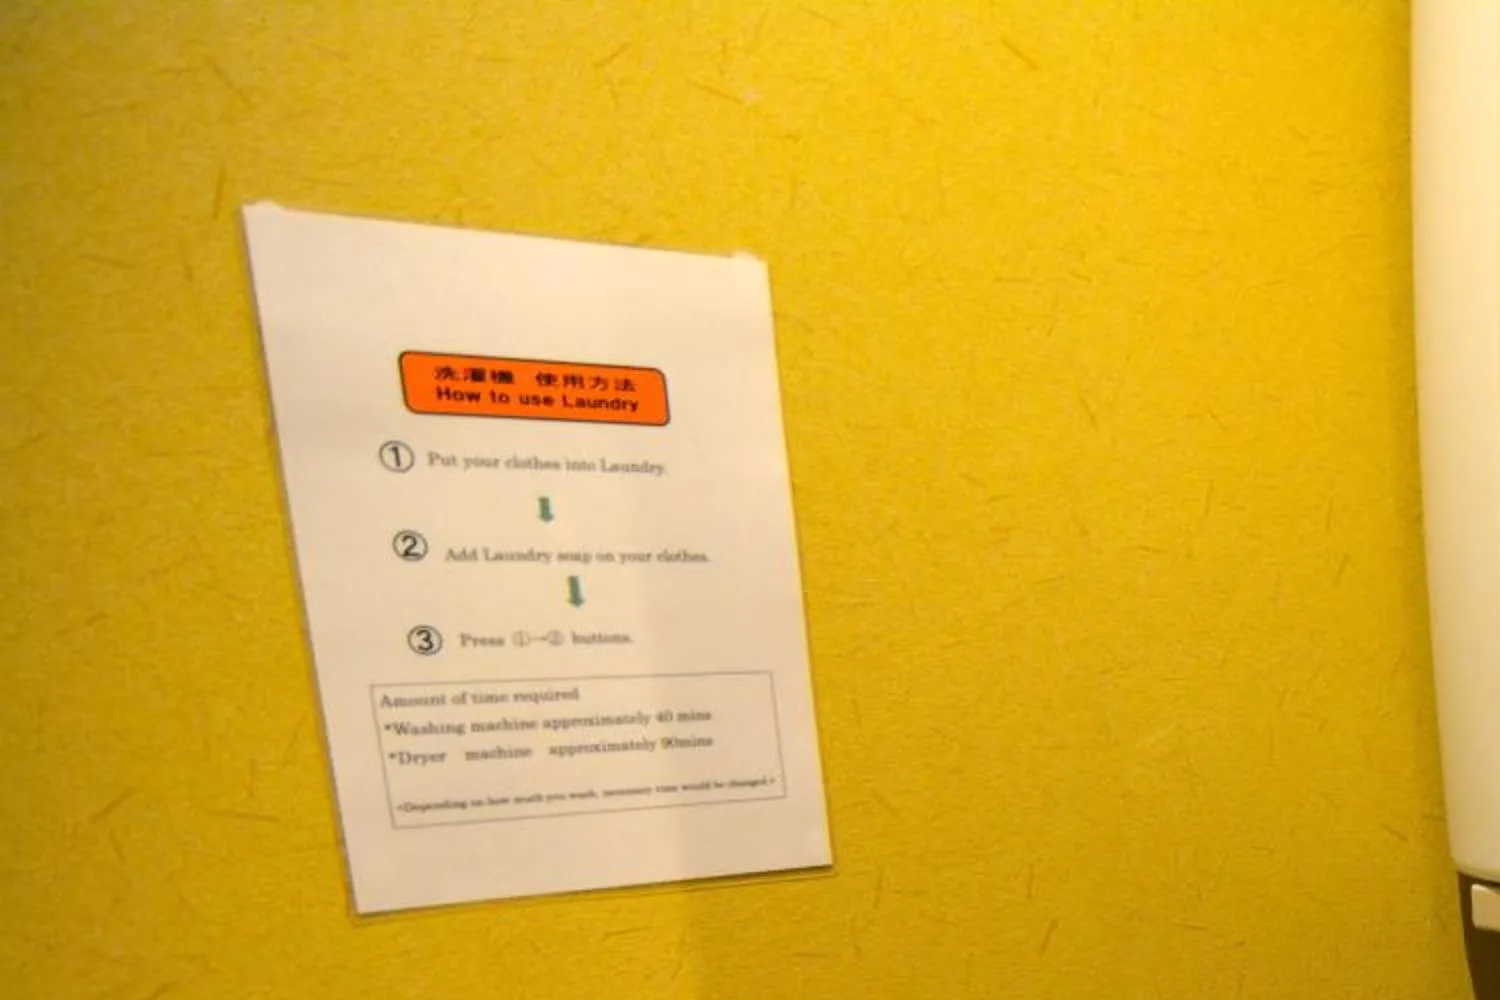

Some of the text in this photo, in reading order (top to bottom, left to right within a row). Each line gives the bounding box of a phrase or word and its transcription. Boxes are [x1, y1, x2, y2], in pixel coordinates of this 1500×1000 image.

[535, 371, 636, 393] 使用方法
[435, 386, 639, 413] How to use Laundry
[427, 451, 459, 467] Put
[463, 455, 499, 471] your
[505, 454, 562, 471] clothes
[565, 457, 597, 472] into
[444, 547, 478, 563] Add
[483, 547, 552, 565] Laundry
[556, 550, 591, 566] soap
[596, 550, 616, 563] on
[619, 550, 652, 565] your
[458, 632, 506, 647] Press
[380, 688, 580, 708] Amount of time required
[470, 717, 537, 733] machine
[542, 711, 652, 732] approximately
[465, 745, 533, 761] machine
[548, 738, 657, 757] approximately
